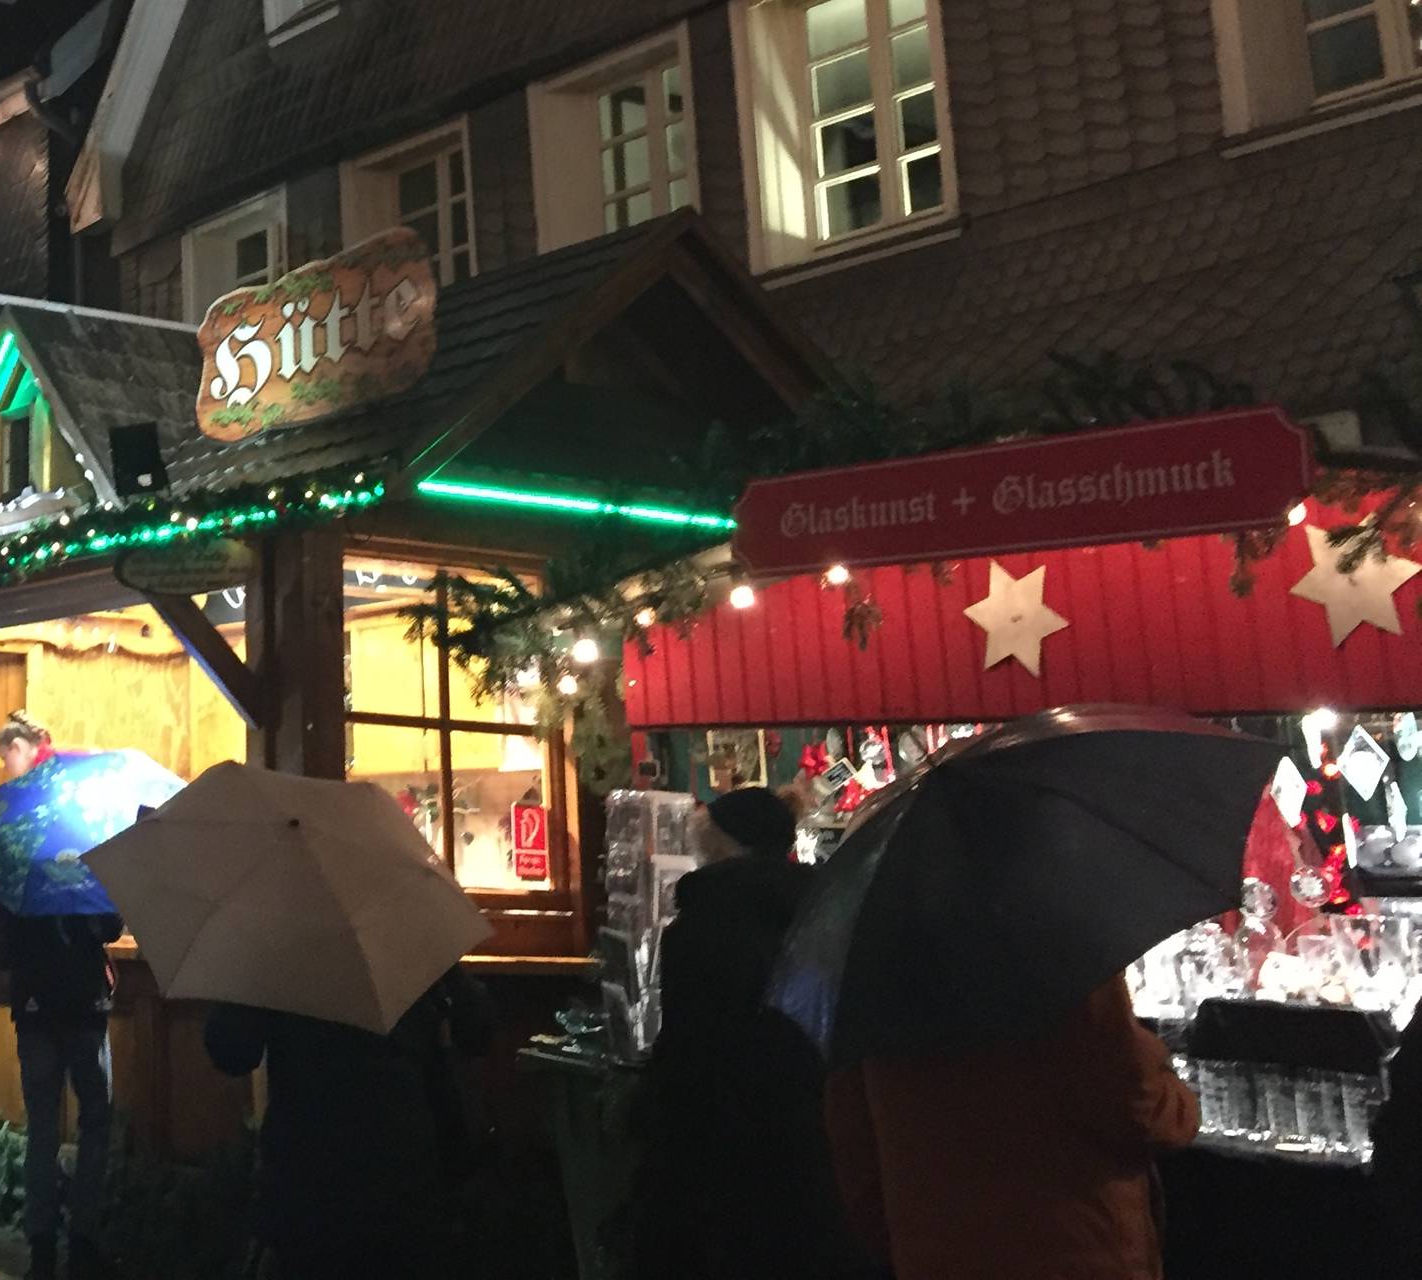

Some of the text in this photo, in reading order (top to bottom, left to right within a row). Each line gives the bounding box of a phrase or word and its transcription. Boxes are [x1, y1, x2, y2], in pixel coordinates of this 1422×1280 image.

[210, 276, 426, 409] Hütte
[780, 492, 936, 539] Glaskunst
[992, 451, 1235, 513] Glasschmuck
